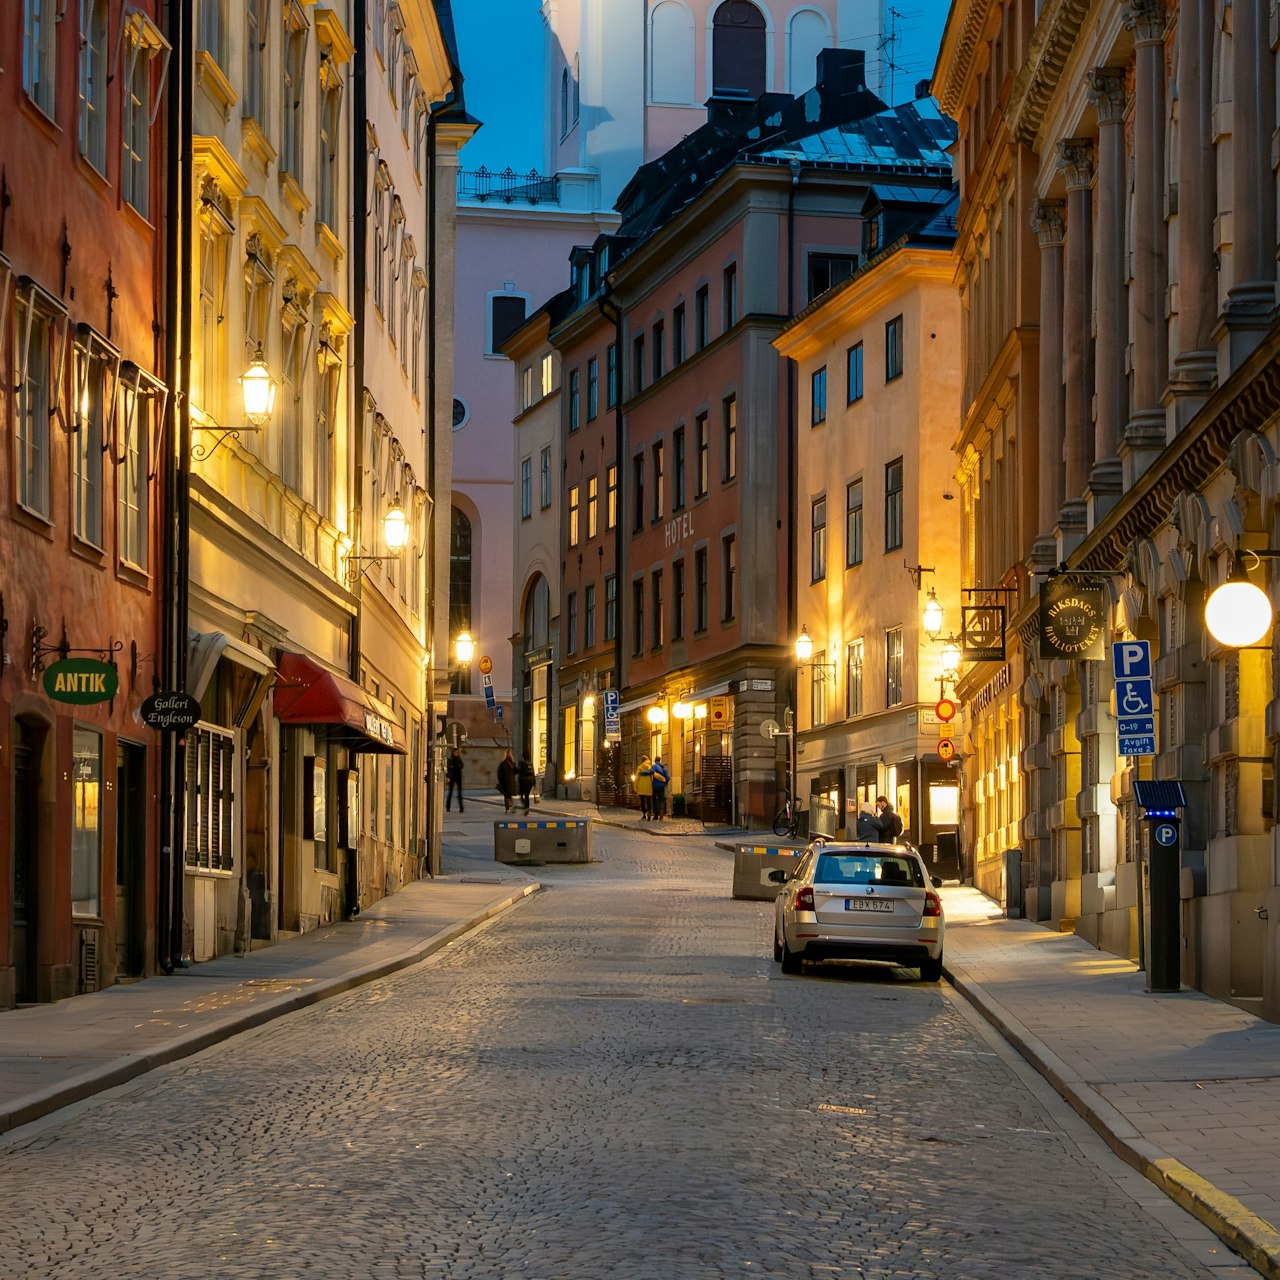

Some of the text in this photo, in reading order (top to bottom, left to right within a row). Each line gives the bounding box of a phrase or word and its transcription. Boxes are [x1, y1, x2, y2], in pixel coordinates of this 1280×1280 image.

[665, 511, 695, 548] HOTEL
[1045, 625, 1099, 653] BIBLIOTEKET
[1122, 645, 1144, 675] P
[54, 672, 106, 693] ANTIK
[154, 697, 188, 711] Galleri
[148, 711, 193, 727] Engleson
[1124, 738, 1149, 747] Avgift
